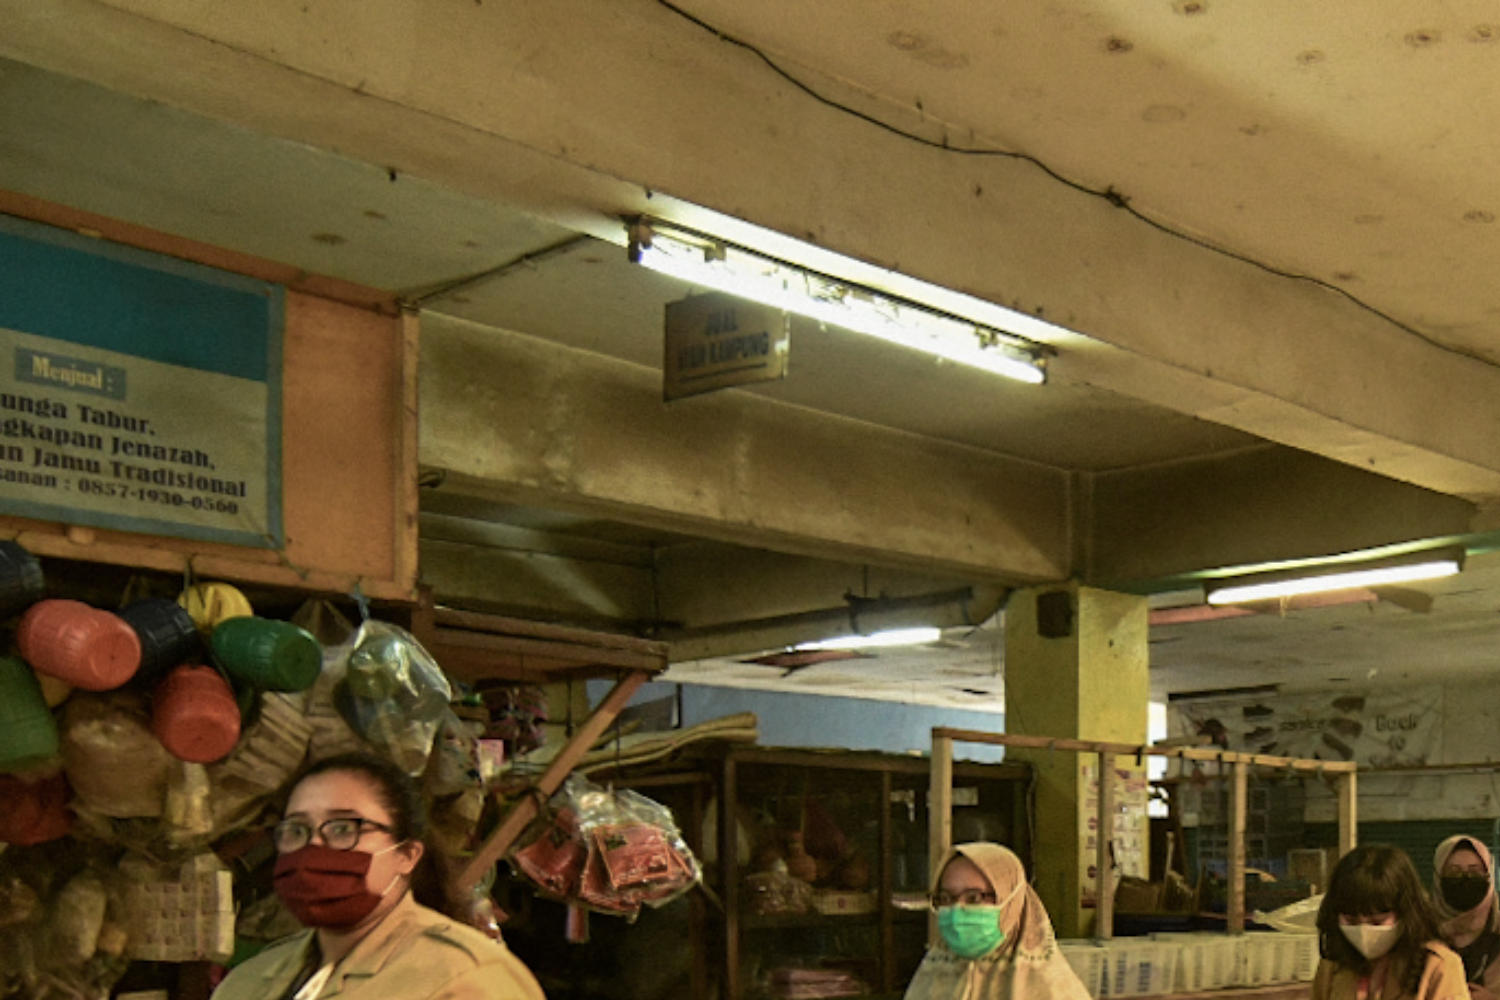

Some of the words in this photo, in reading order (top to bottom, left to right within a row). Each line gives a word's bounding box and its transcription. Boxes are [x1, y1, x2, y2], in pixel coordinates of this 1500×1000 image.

[32, 355, 103, 389] Menjual
[0, 418, 103, 450] gkapan
[76, 403, 156, 436] Tabur.
[34, 447, 101, 475] Jamu
[109, 461, 247, 498] Tradisional
